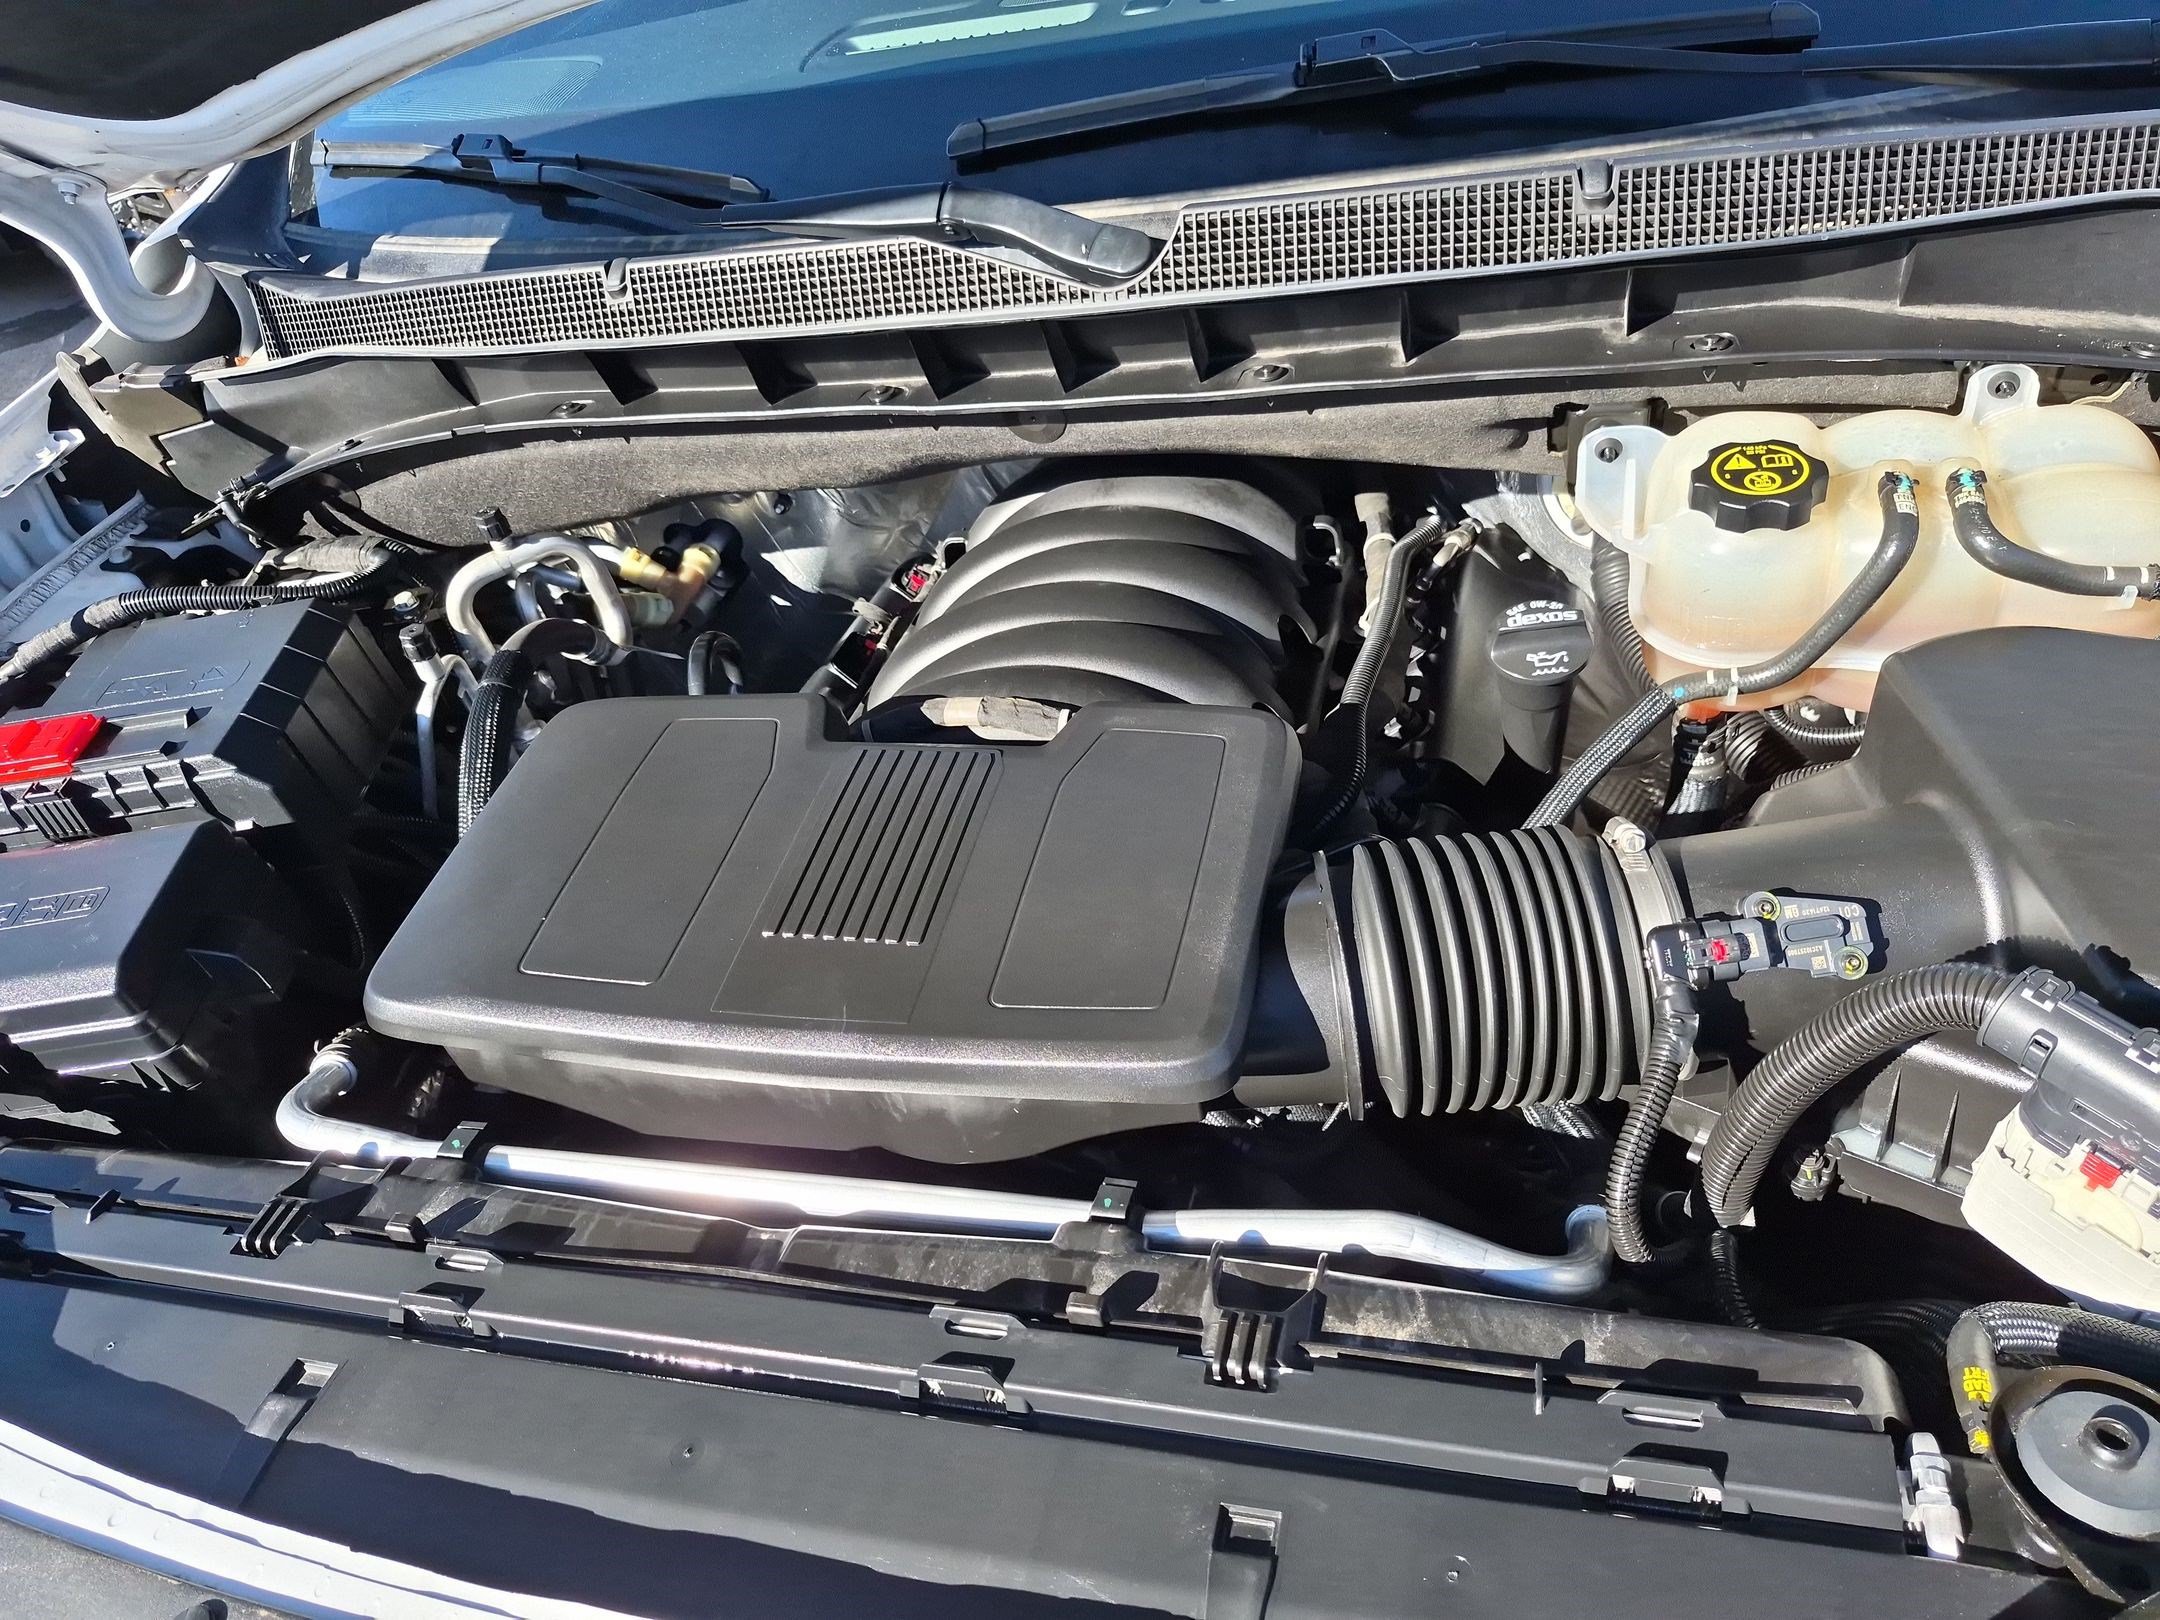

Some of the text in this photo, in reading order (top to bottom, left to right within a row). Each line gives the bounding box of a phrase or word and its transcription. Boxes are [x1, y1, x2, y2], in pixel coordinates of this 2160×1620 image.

[1506, 603, 1527, 616] SAE
[1507, 610, 1577, 627] dexos
[1784, 904, 1800, 918] GM
